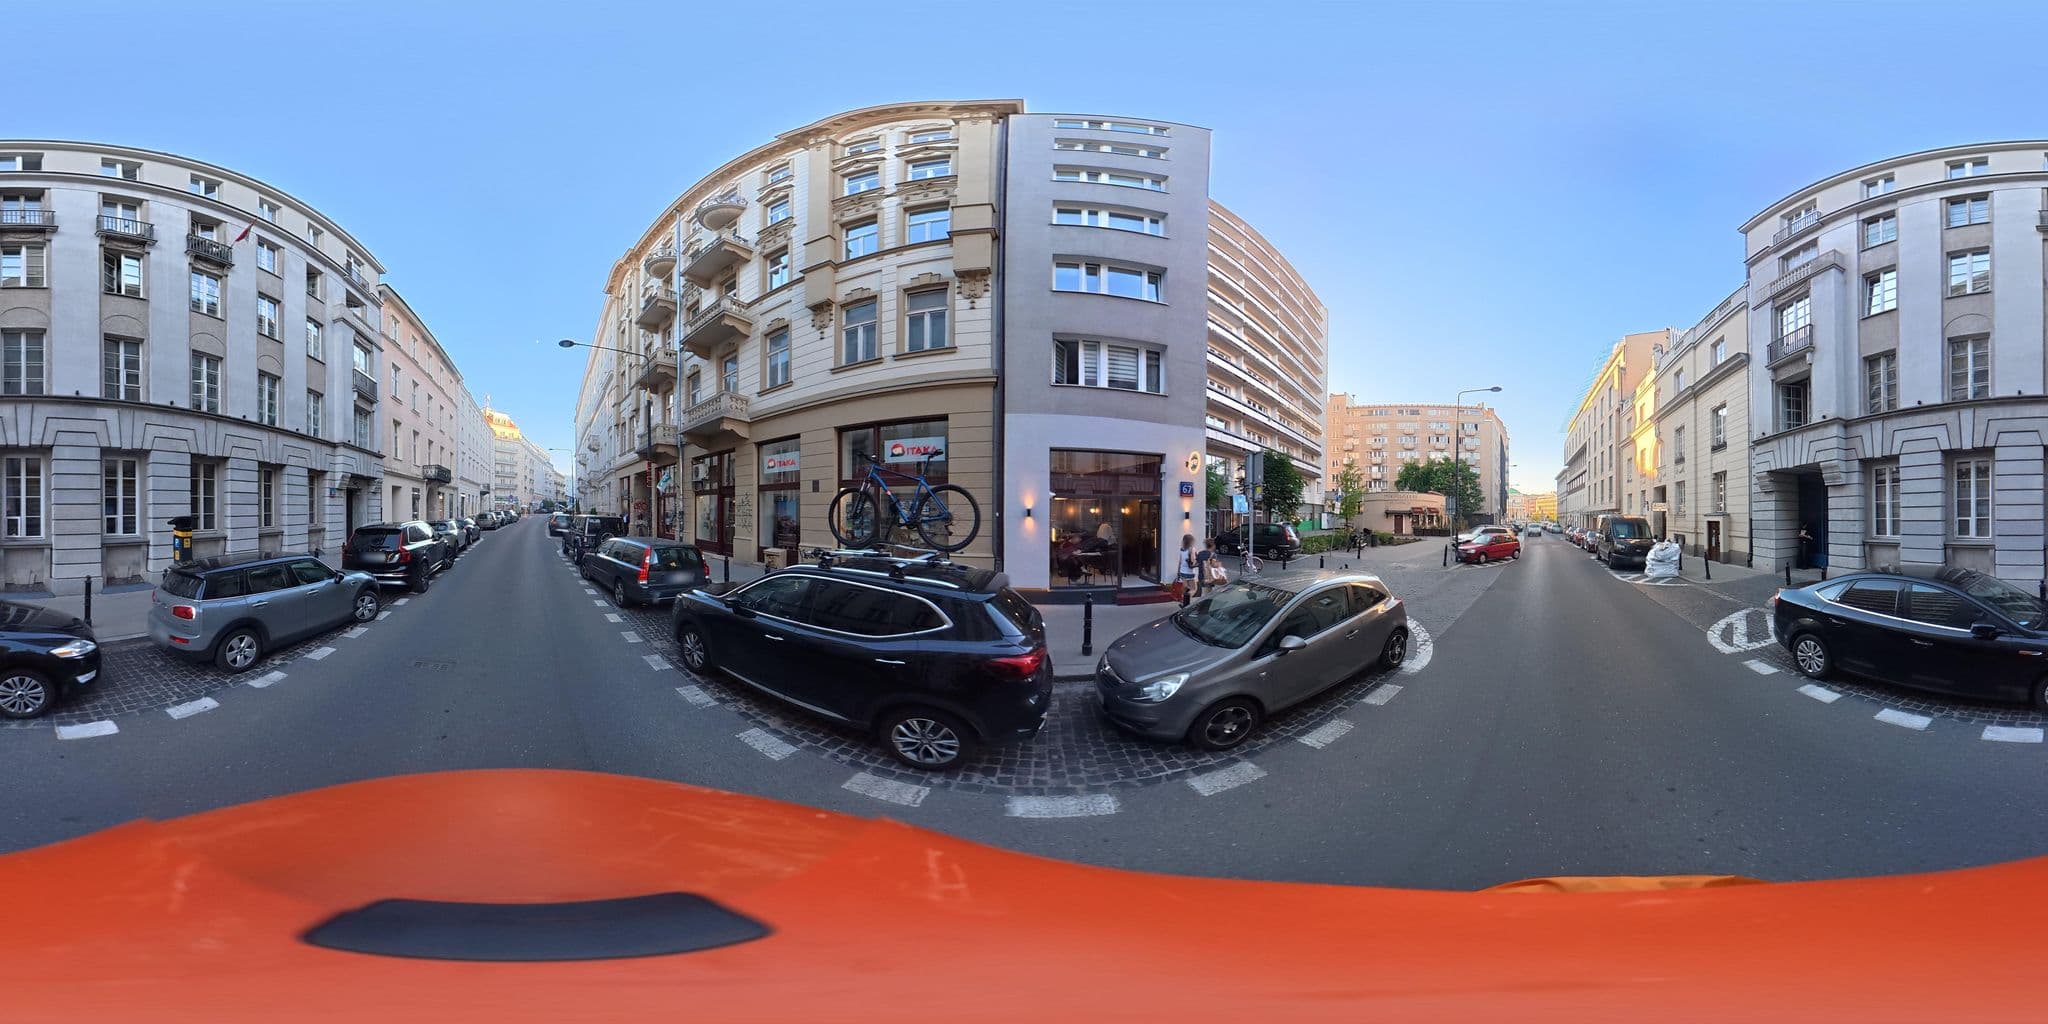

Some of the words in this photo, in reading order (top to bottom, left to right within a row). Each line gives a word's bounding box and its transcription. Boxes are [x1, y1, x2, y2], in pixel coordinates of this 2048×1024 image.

[906, 446, 938, 456] ITAKA
[777, 458, 796, 468] ITAKA
[1182, 485, 1192, 494] 67
